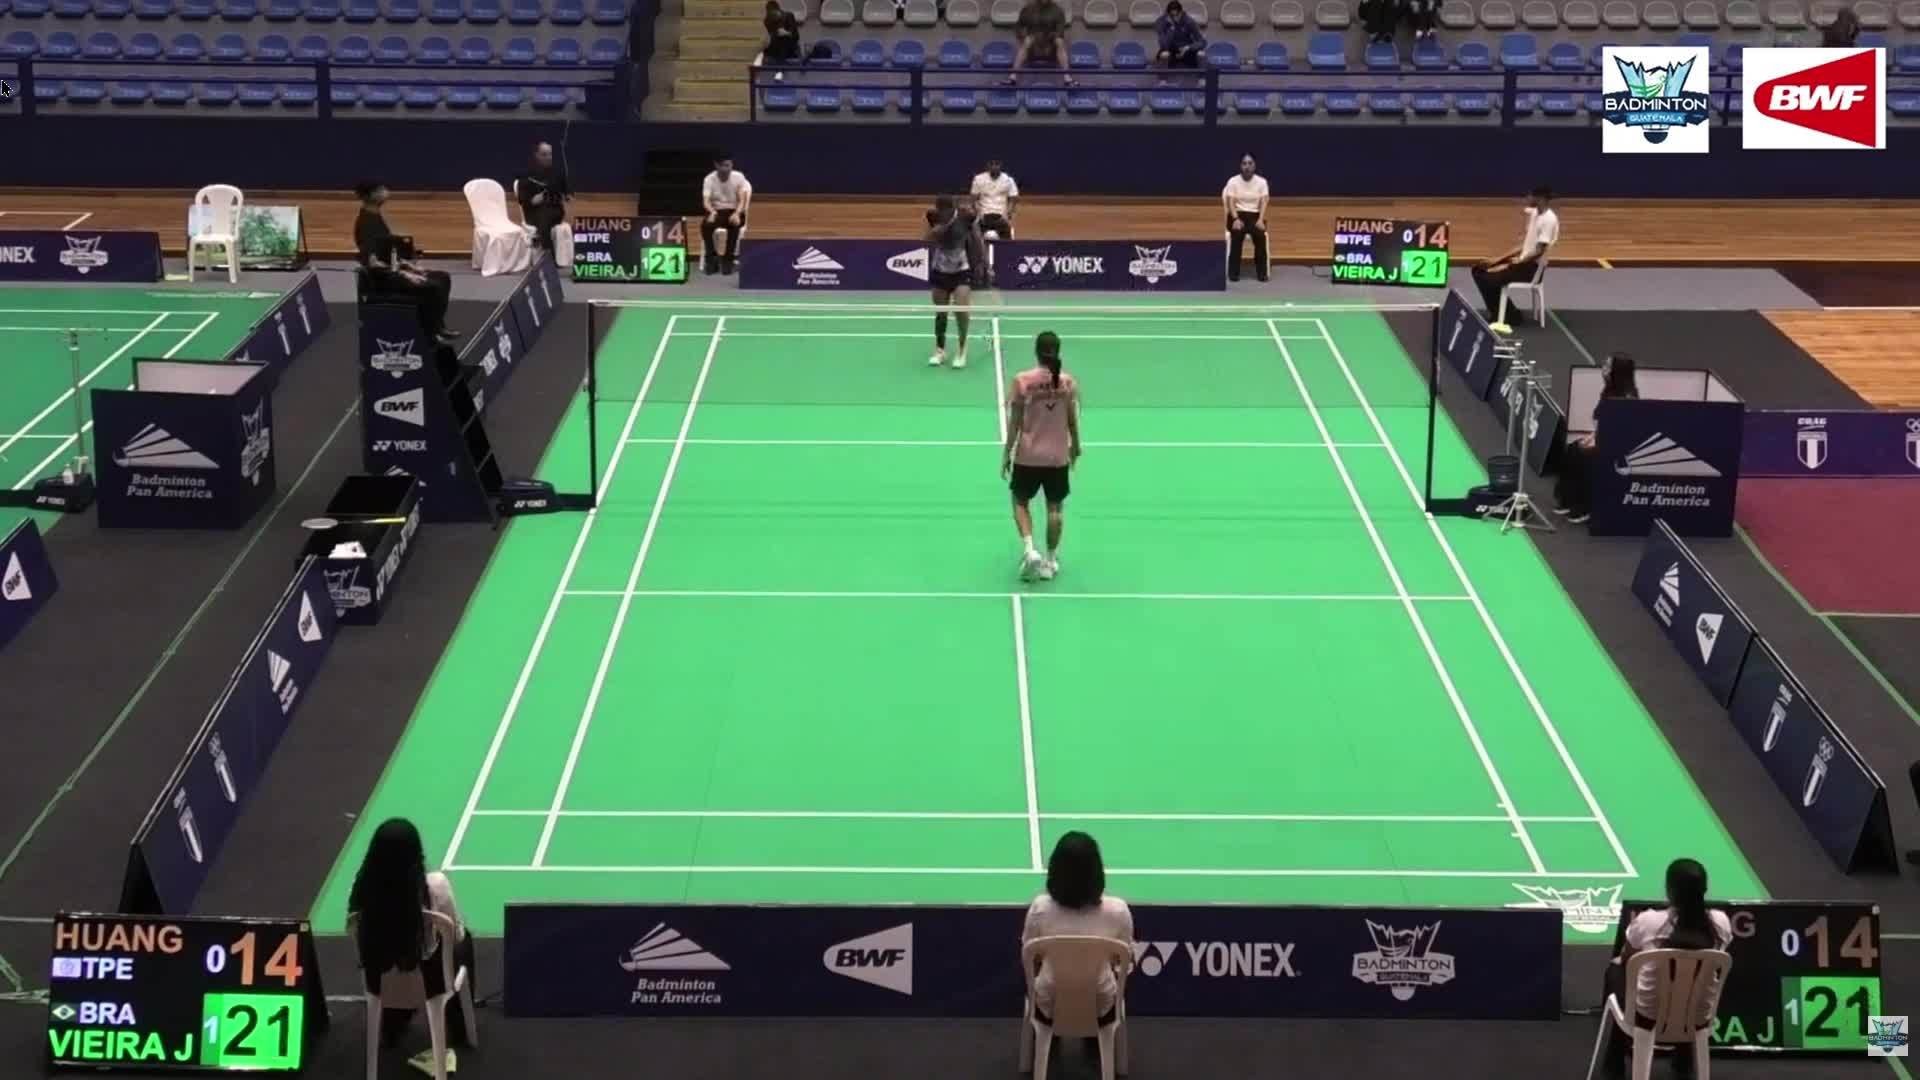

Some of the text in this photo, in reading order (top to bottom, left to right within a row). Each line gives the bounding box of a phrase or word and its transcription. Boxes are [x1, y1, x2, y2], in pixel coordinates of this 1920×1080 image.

[575, 218, 632, 232] HUANG
[641, 220, 684, 245] 0 14
[1336, 219, 1394, 234] HUANG
[586, 232, 611, 243] TPE
[1349, 233, 1372, 246] TPE
[1402, 223, 1449, 249] 0 14
[0, 246, 36, 263] NEX
[586, 251, 613, 263] BRA
[1346, 252, 1373, 265] BRA
[574, 264, 638, 278] VIEIRA J
[650, 252, 680, 275] 21
[892, 258, 924, 268] BWF
[1052, 256, 1104, 274] YONEX
[1411, 255, 1441, 278] 21
[1333, 265, 1398, 281] VIEIRA J
[381, 401, 419, 412] BWF
[393, 440, 427, 451] YONEX
[131, 473, 206, 487] Badminton
[1629, 481, 1706, 495] Badminton
[127, 485, 213, 499] Pan America
[1622, 493, 1711, 507] Pan America
[55, 922, 184, 954] HUANG
[1780, 928, 1800, 957] 0
[1804, 914, 1879, 969] 14
[205, 930, 304, 987] 0 14
[833, 947, 906, 968] BWF
[1185, 941, 1297, 977] YONEX
[1357, 958, 1451, 970] BADMINTON
[82, 956, 134, 980] TPE
[637, 978, 717, 991] Badminton
[630, 991, 722, 1004] Pan America
[79, 1001, 136, 1025] BRA
[1783, 984, 1872, 1039] 1 21
[203, 1003, 290, 1058] 1 21
[1756, 1015, 1775, 1044] J
[48, 1029, 194, 1062] VIEIRA J
